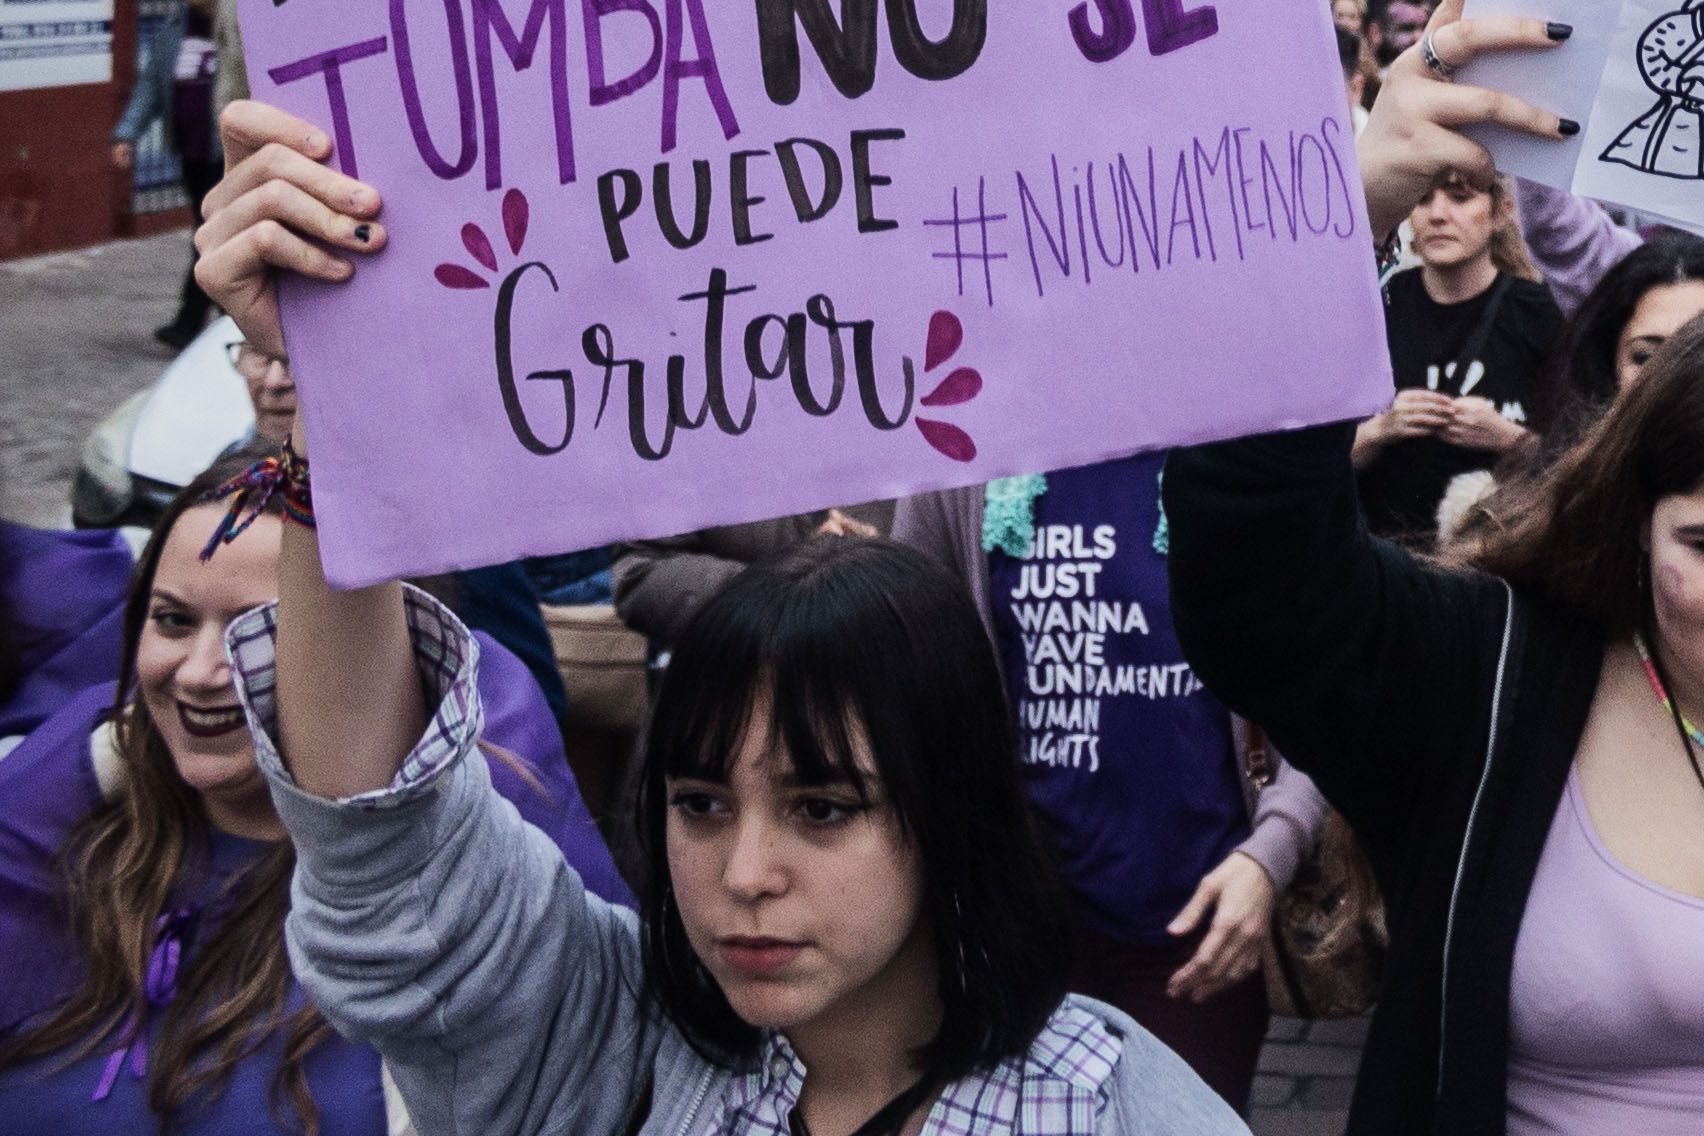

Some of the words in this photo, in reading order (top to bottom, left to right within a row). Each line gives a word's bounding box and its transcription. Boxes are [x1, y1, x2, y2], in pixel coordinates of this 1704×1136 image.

[597, 128, 906, 264] PUEDE
[493, 261, 915, 461] Gritar
[1010, 562, 1103, 600] JUST
[1010, 600, 1150, 635] WANNA
[1022, 732, 1100, 773] IGHTS
